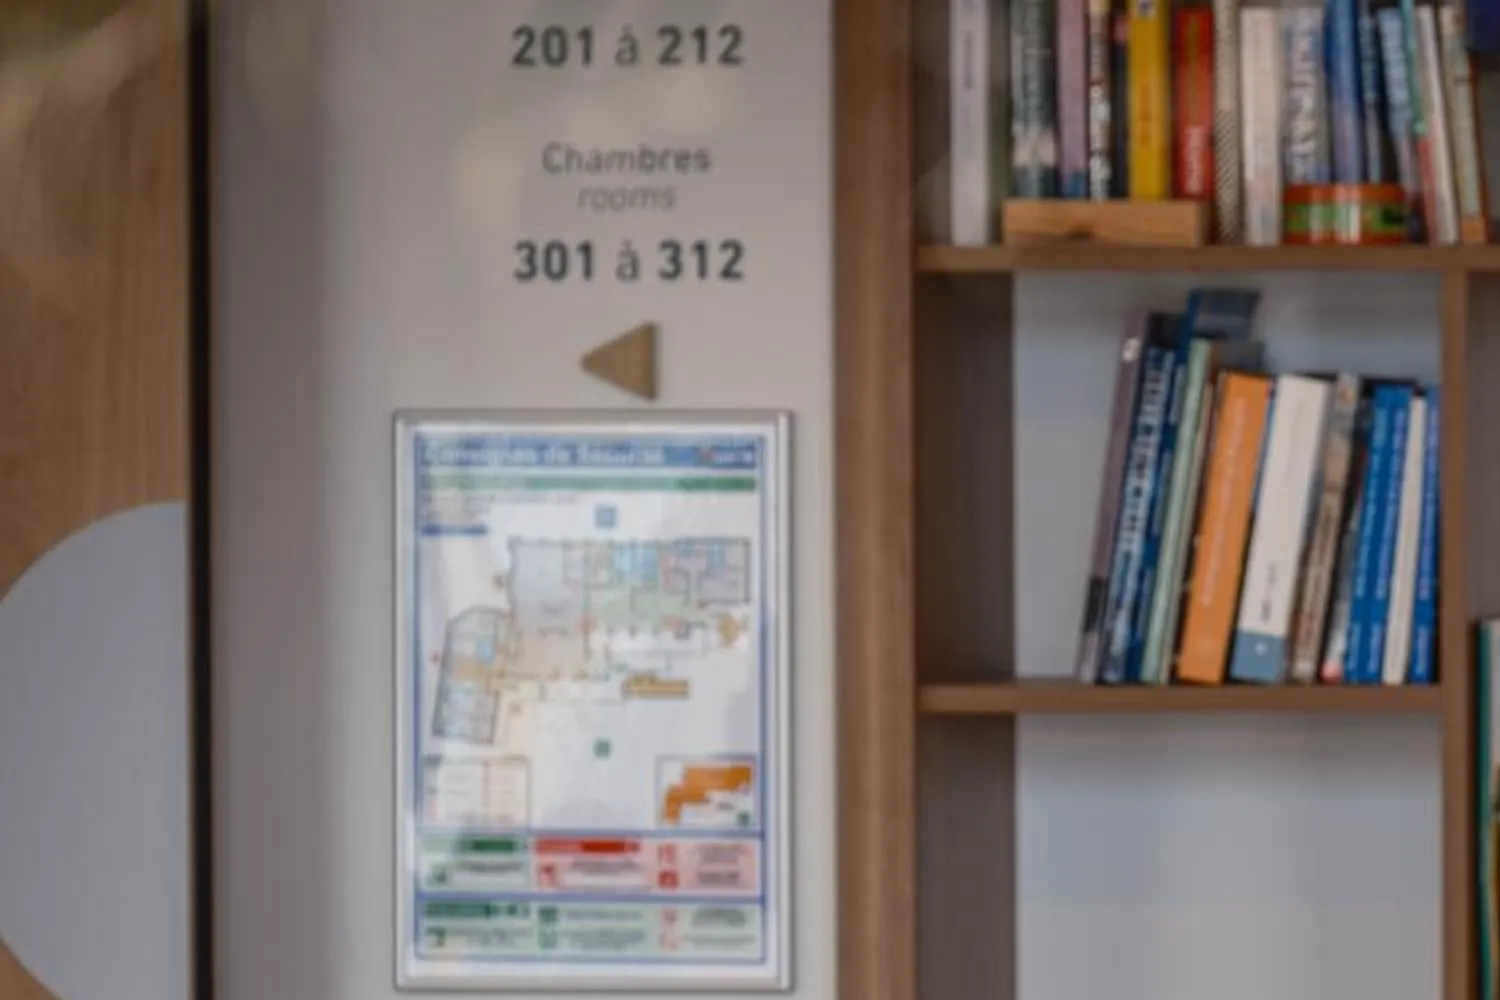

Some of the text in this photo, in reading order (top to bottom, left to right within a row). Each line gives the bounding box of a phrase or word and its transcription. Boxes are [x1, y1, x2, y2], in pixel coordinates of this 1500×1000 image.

[511, 24, 744, 67] 201 à 212
[541, 141, 712, 174] Chambres
[577, 186, 678, 212] rooms
[513, 239, 745, 282] 301 à 312
